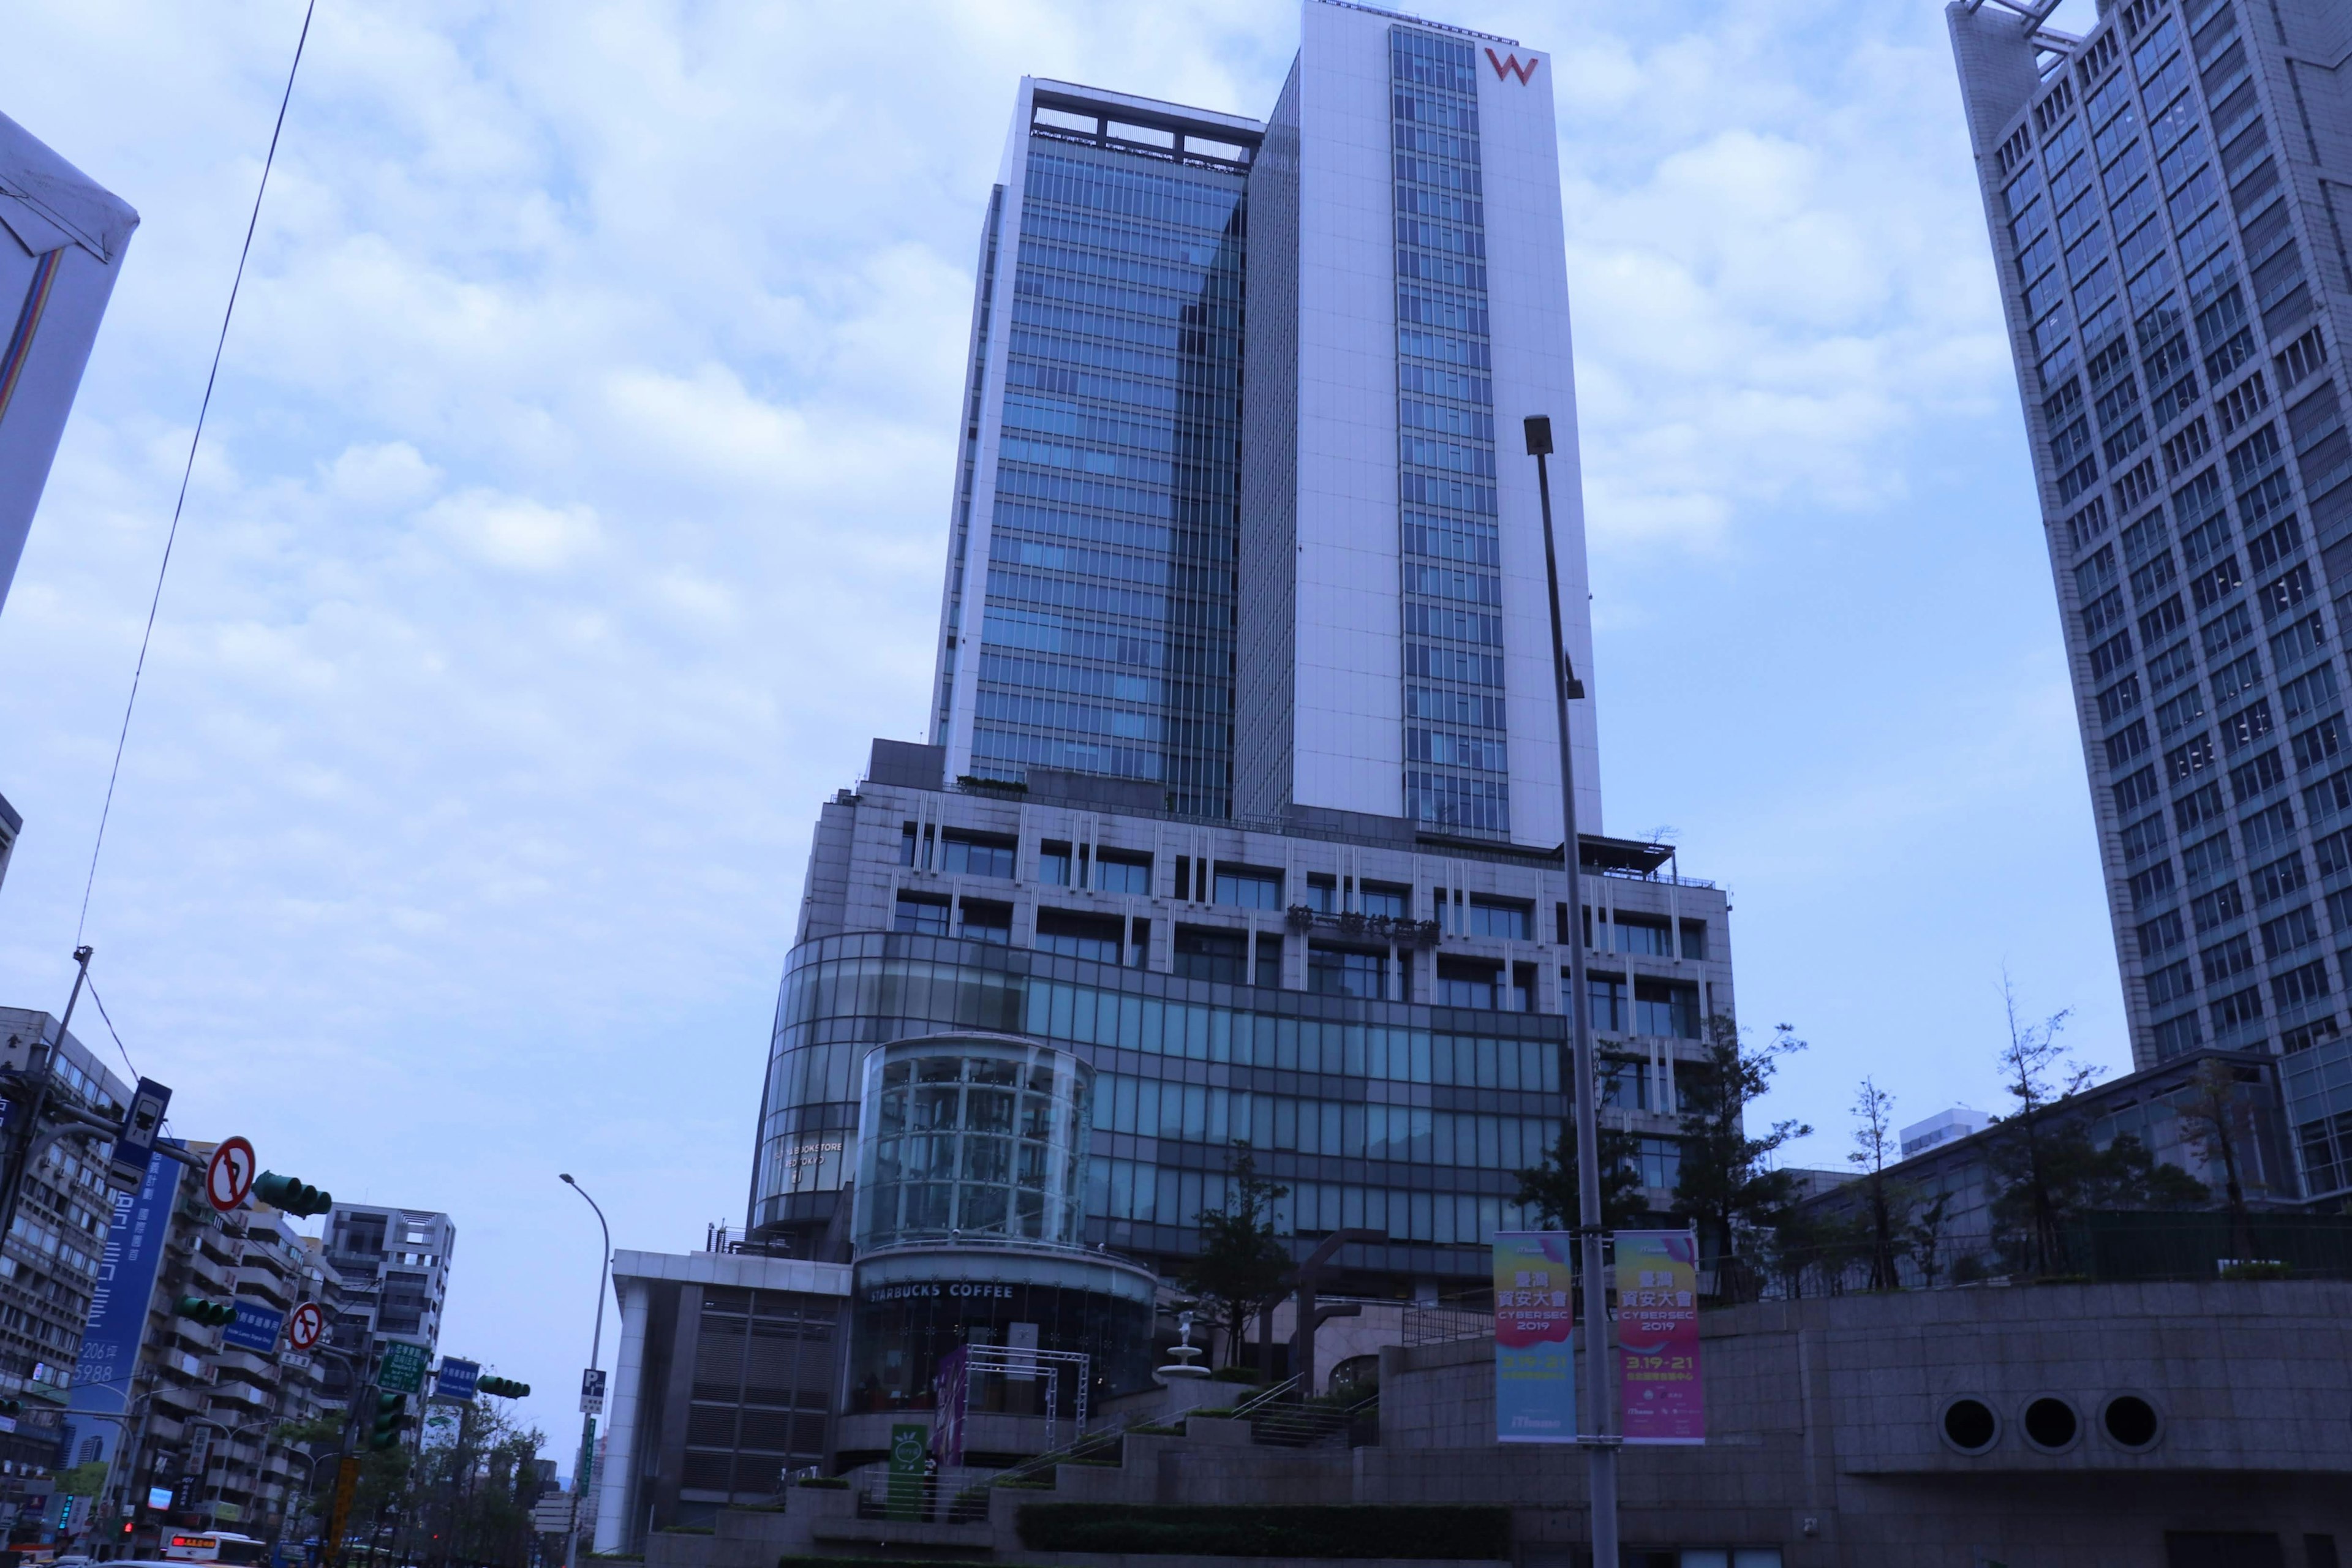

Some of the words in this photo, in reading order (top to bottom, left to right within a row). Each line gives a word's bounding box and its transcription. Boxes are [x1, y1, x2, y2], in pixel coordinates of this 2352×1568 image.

[1485, 48, 1538, 86] W
[871, 1284, 940, 1302] STARBUCKS
[949, 1284, 1013, 1298] COFFEE
[1498, 1291, 1567, 1308] 資安大會
[1622, 1291, 1692, 1308] 資安大會
[1498, 1311, 1568, 1319] CYBERSEC
[1622, 1311, 1694, 1320] CYBERSEC
[1517, 1322, 1550, 1330] 2019
[1641, 1322, 1675, 1331] 2019
[584, 1370, 598, 1387] P
